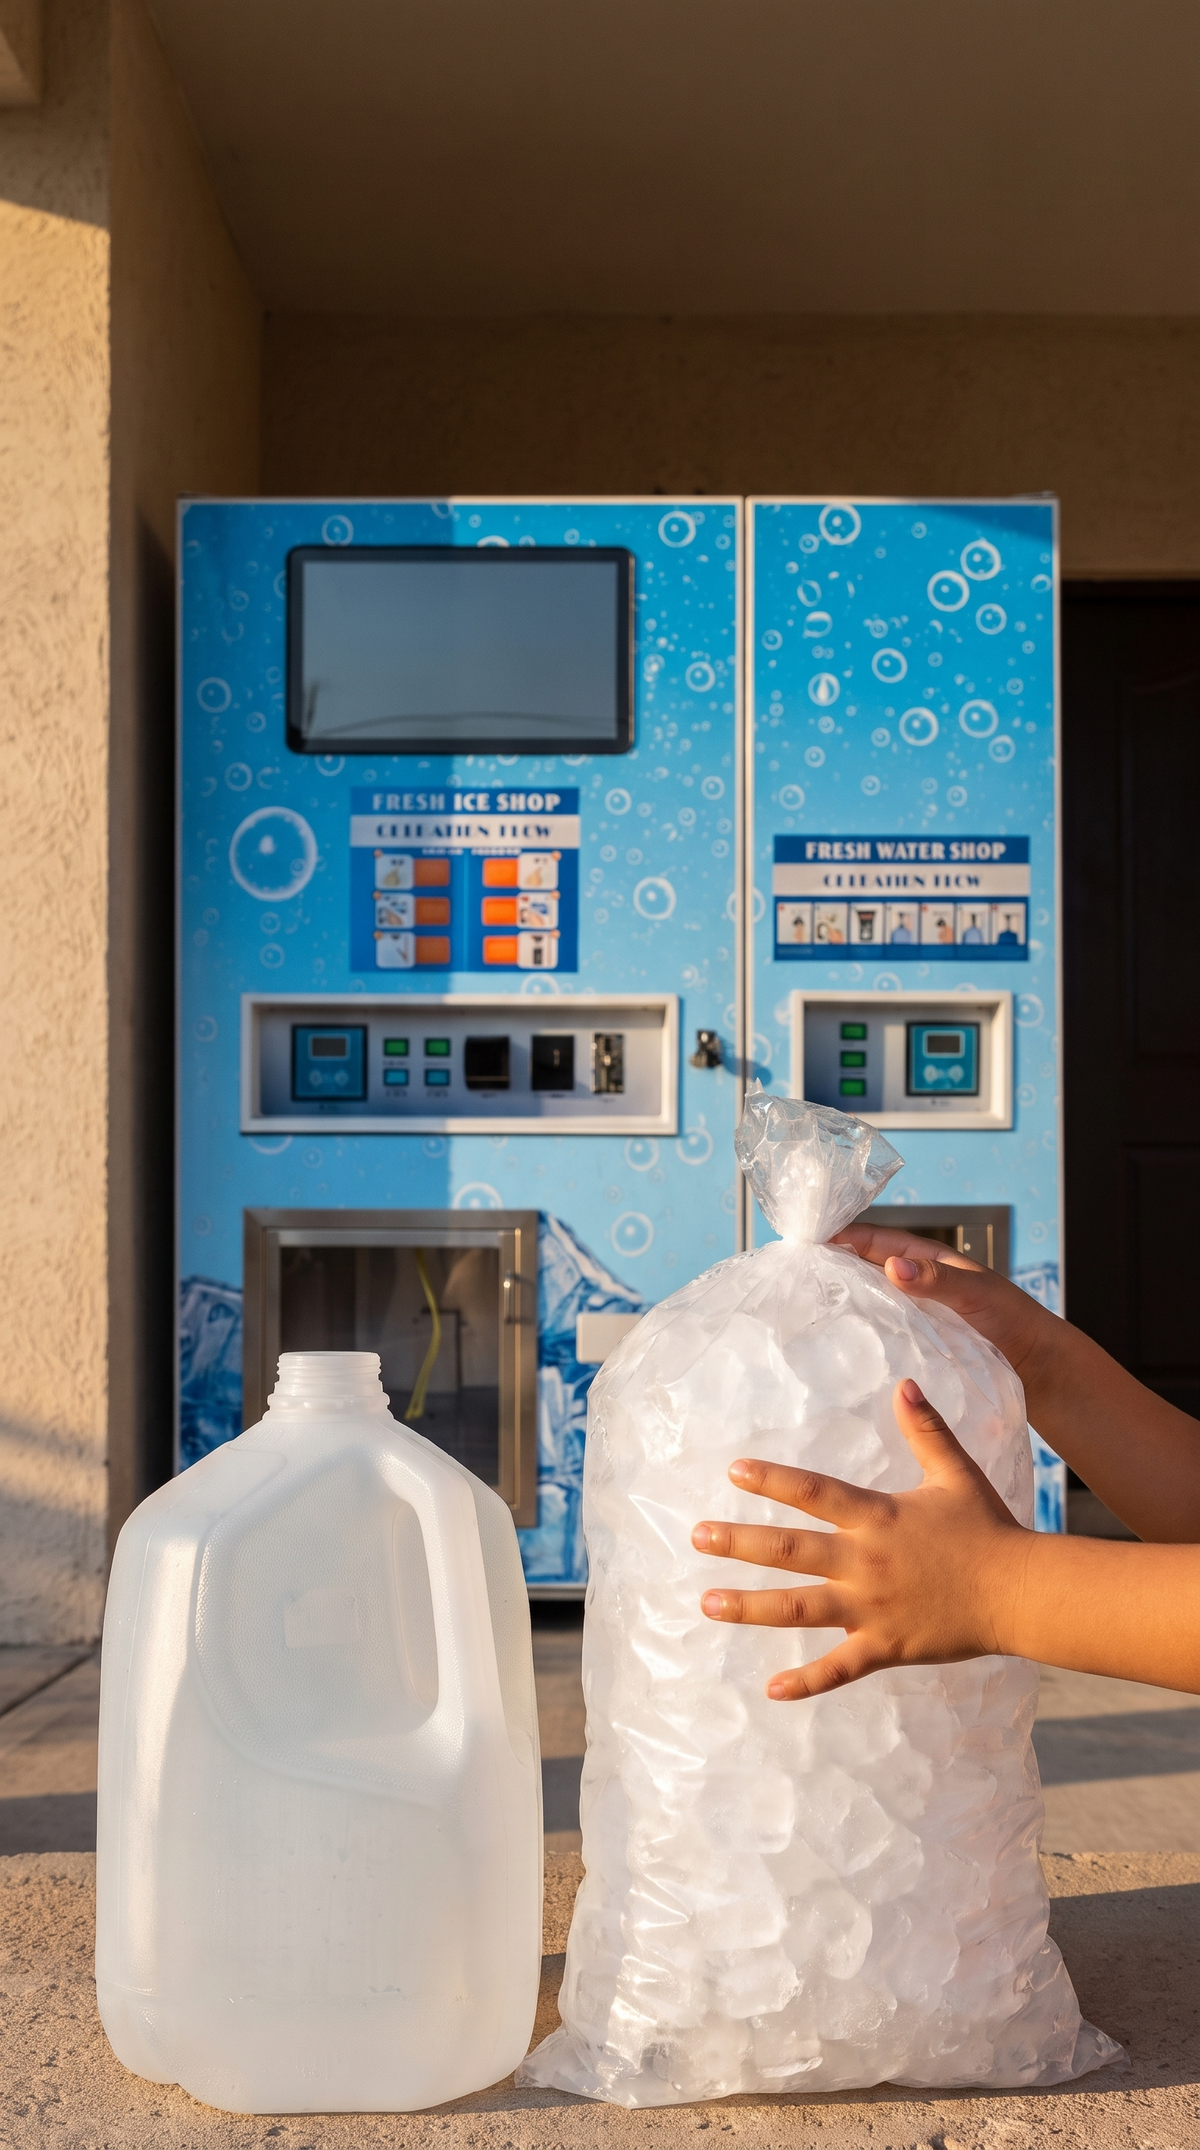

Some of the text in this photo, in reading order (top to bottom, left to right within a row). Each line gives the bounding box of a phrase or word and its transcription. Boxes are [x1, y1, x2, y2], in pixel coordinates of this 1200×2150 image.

[372, 792, 562, 812] FRESH ICE SHOP
[805, 841, 1007, 860] FRESH WATER SHOP
